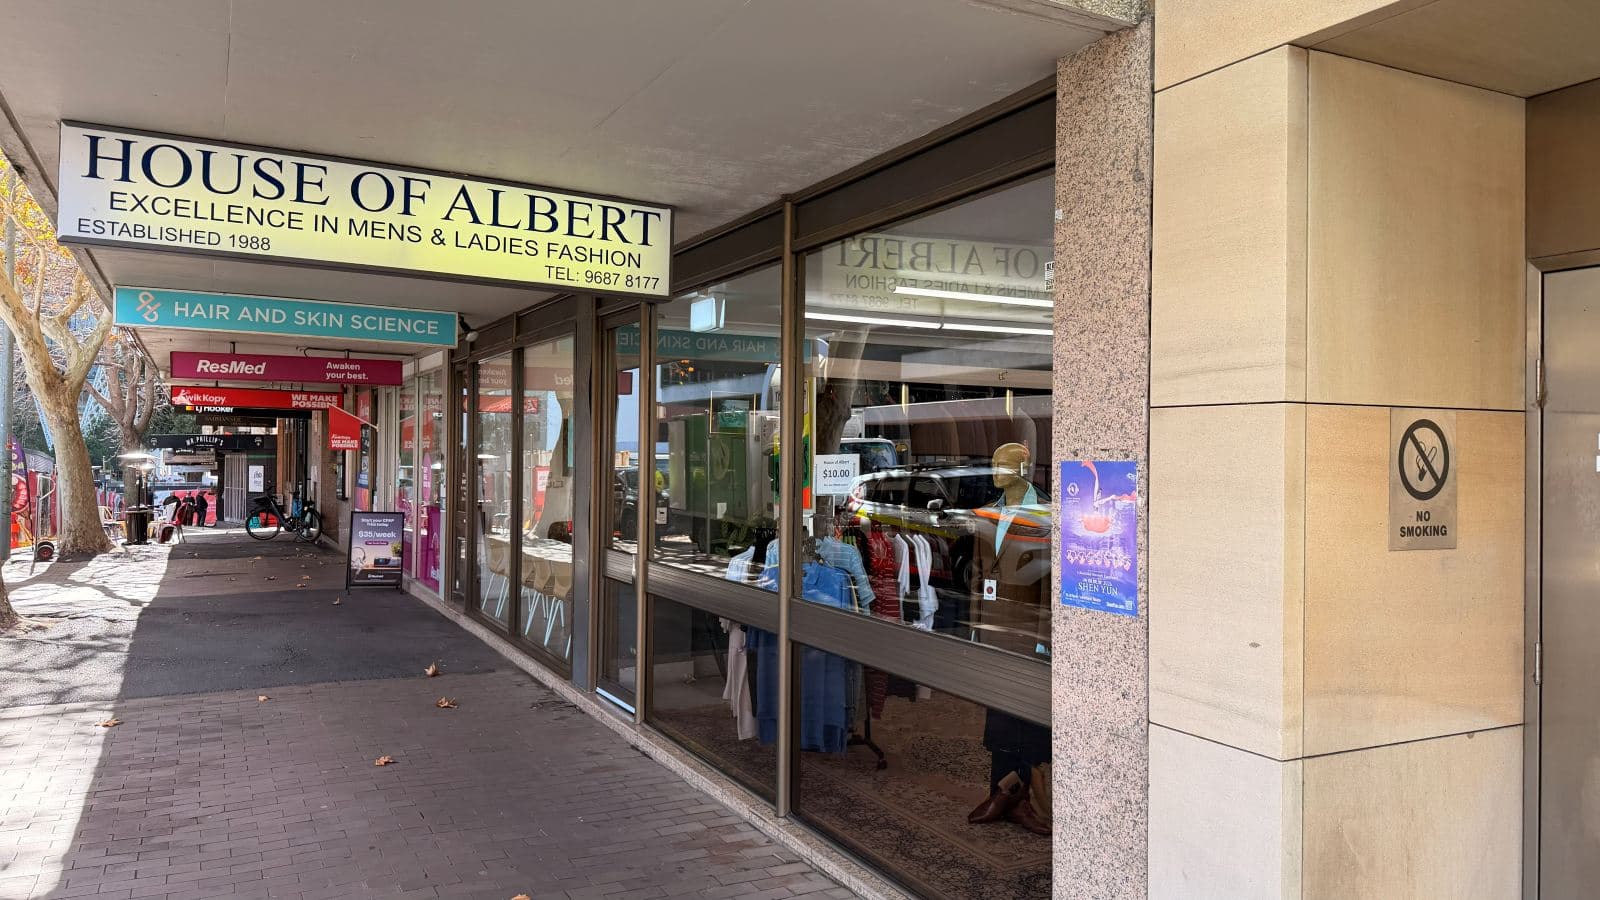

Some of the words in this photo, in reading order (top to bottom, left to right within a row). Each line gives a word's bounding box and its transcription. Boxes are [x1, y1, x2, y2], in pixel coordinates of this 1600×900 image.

[81, 134, 330, 206] HOUSE
[350, 171, 431, 216] OF
[441, 184, 661, 246] ALBERT
[77, 218, 221, 246] ESTABLISHED
[228, 234, 271, 250] 1988
[110, 190, 304, 230] EXCELLENCE
[314, 214, 338, 234] IN
[348, 218, 422, 243] MENS
[430, 228, 446, 246] &
[455, 230, 538, 257] LADIES
[547, 242, 641, 269] FASHION
[544, 265, 580, 283] TEL:
[584, 269, 619, 286] 9687
[625, 273, 660, 290] 8177
[174, 301, 229, 320] HAIR
[237, 306, 287, 324] AND
[294, 311, 344, 329] SKIN
[351, 315, 439, 335] SCIENCE
[197, 359, 266, 375] ResMed
[326, 361, 361, 371] Awaken
[326, 372, 345, 380] your
[348, 371, 369, 380] best.
[203, 393, 226, 405] Kopy
[310, 394, 338, 402] MAKE
[823, 469, 850, 479] $10.00
[1416, 511, 1430, 522] NO
[1400, 525, 1447, 537] SMOKING
[1078, 581, 1099, 593] SHEN
[1101, 585, 1118, 596] YUN
